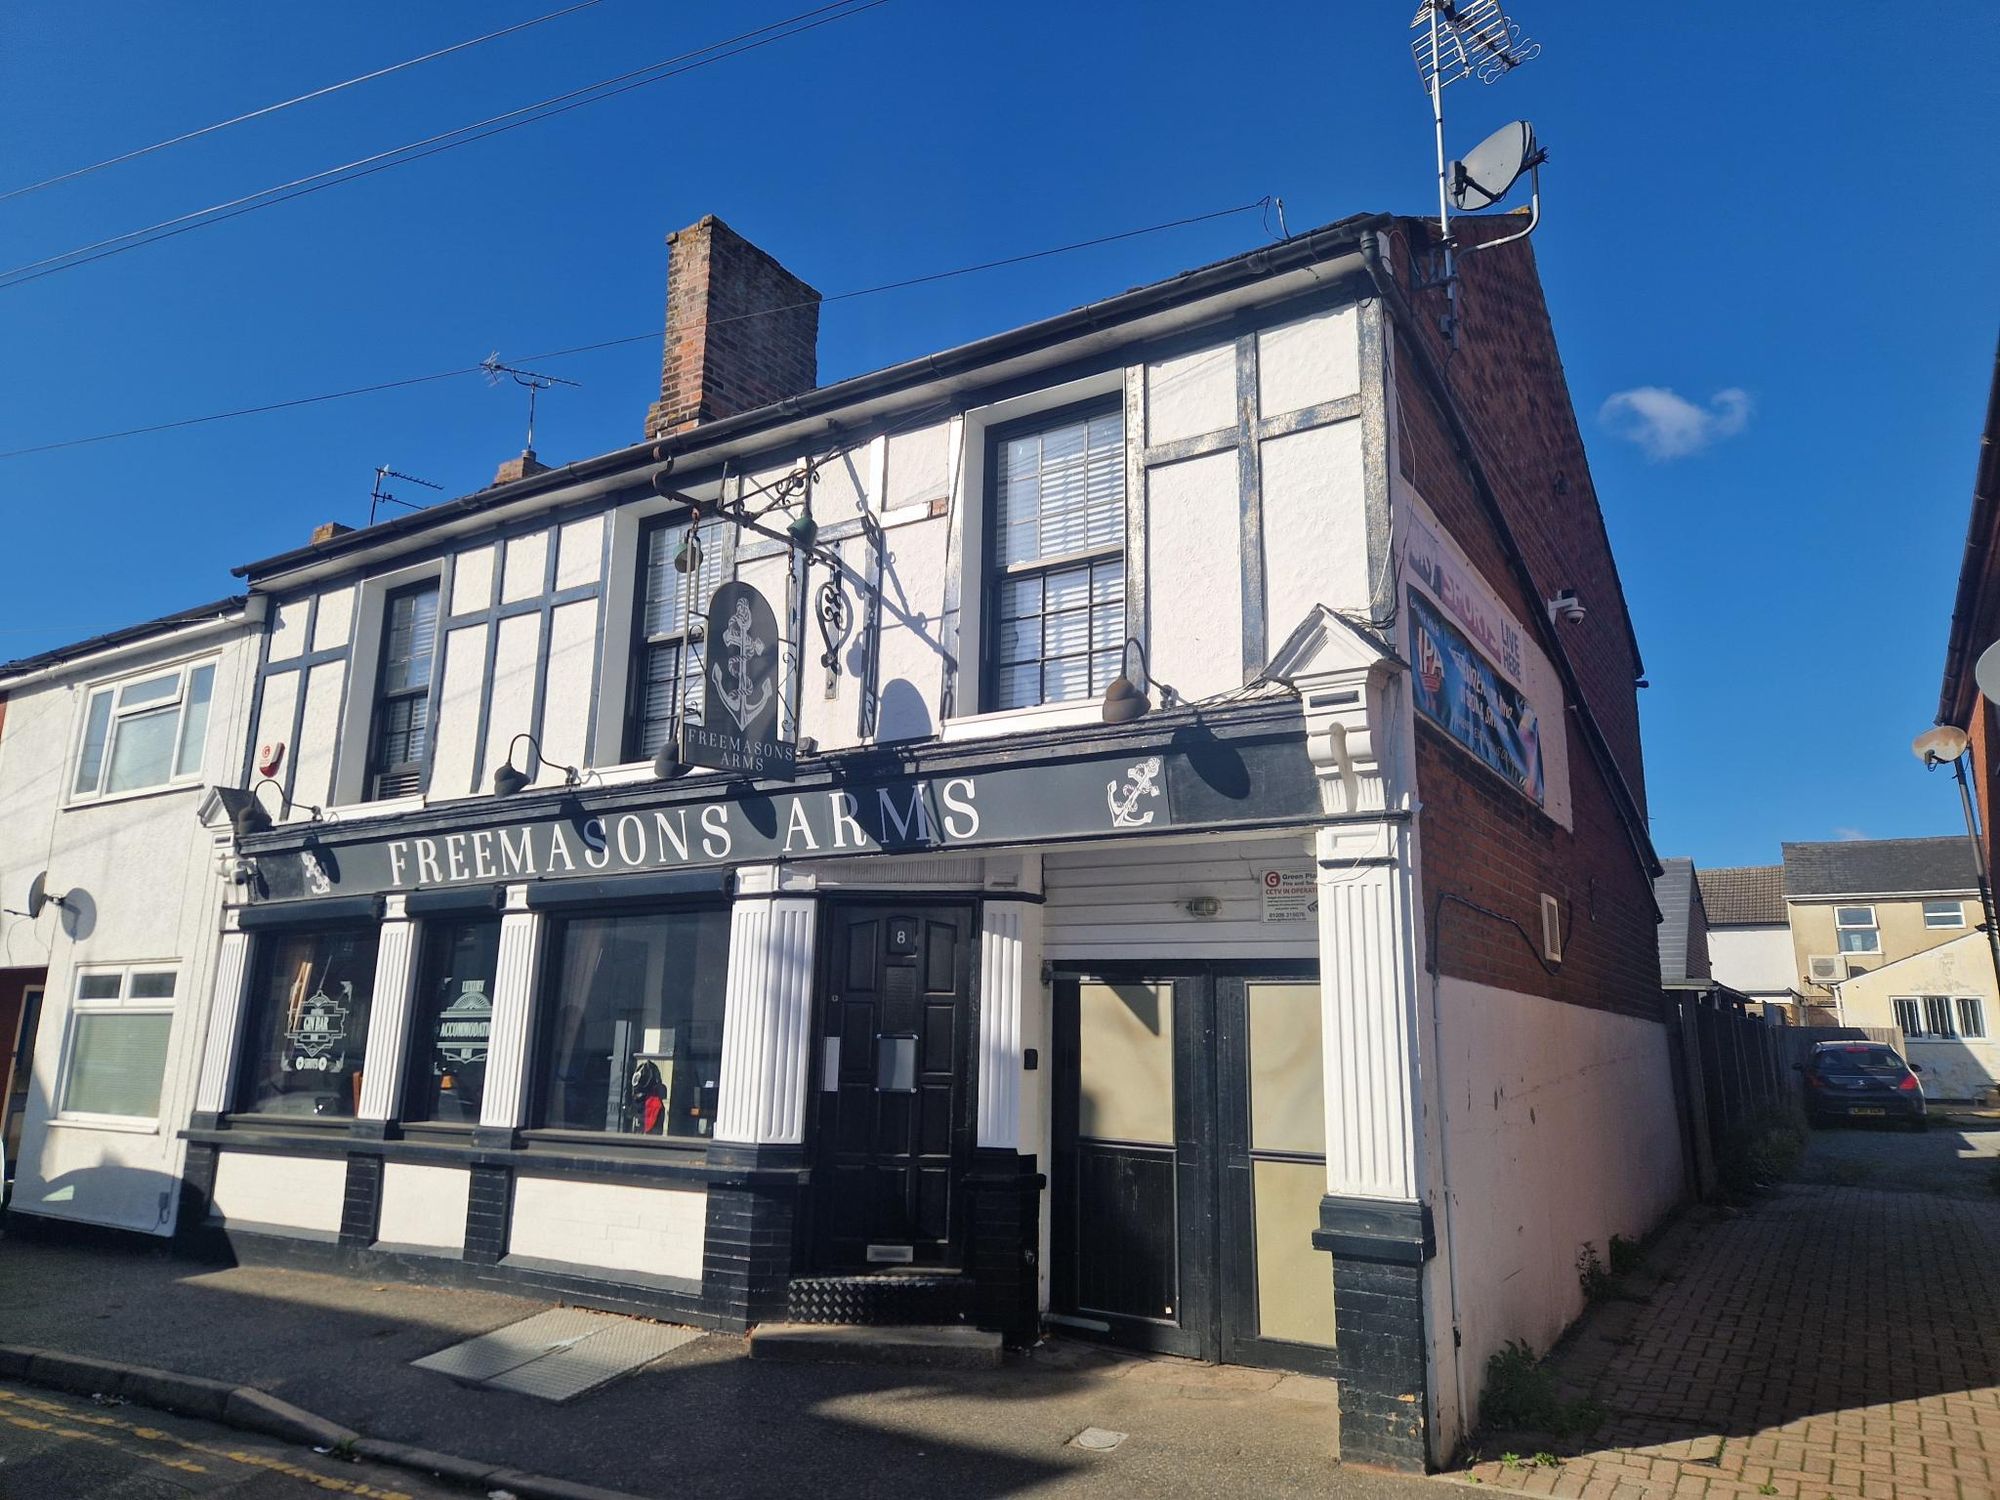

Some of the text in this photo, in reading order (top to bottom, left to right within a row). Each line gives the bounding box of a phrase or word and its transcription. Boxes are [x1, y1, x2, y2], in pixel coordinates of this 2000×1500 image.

[1501, 618, 1520, 659] LIVE
[1418, 627, 1446, 679] IPA
[688, 728, 793, 761] FREEMASONS
[721, 752, 764, 771] ARMS
[387, 778, 980, 887] FREEMASONS ARMS
[896, 930, 906, 945] 8
[315, 1016, 329, 1032] BAR
[440, 1021, 491, 1038] ACCOMMODATI
